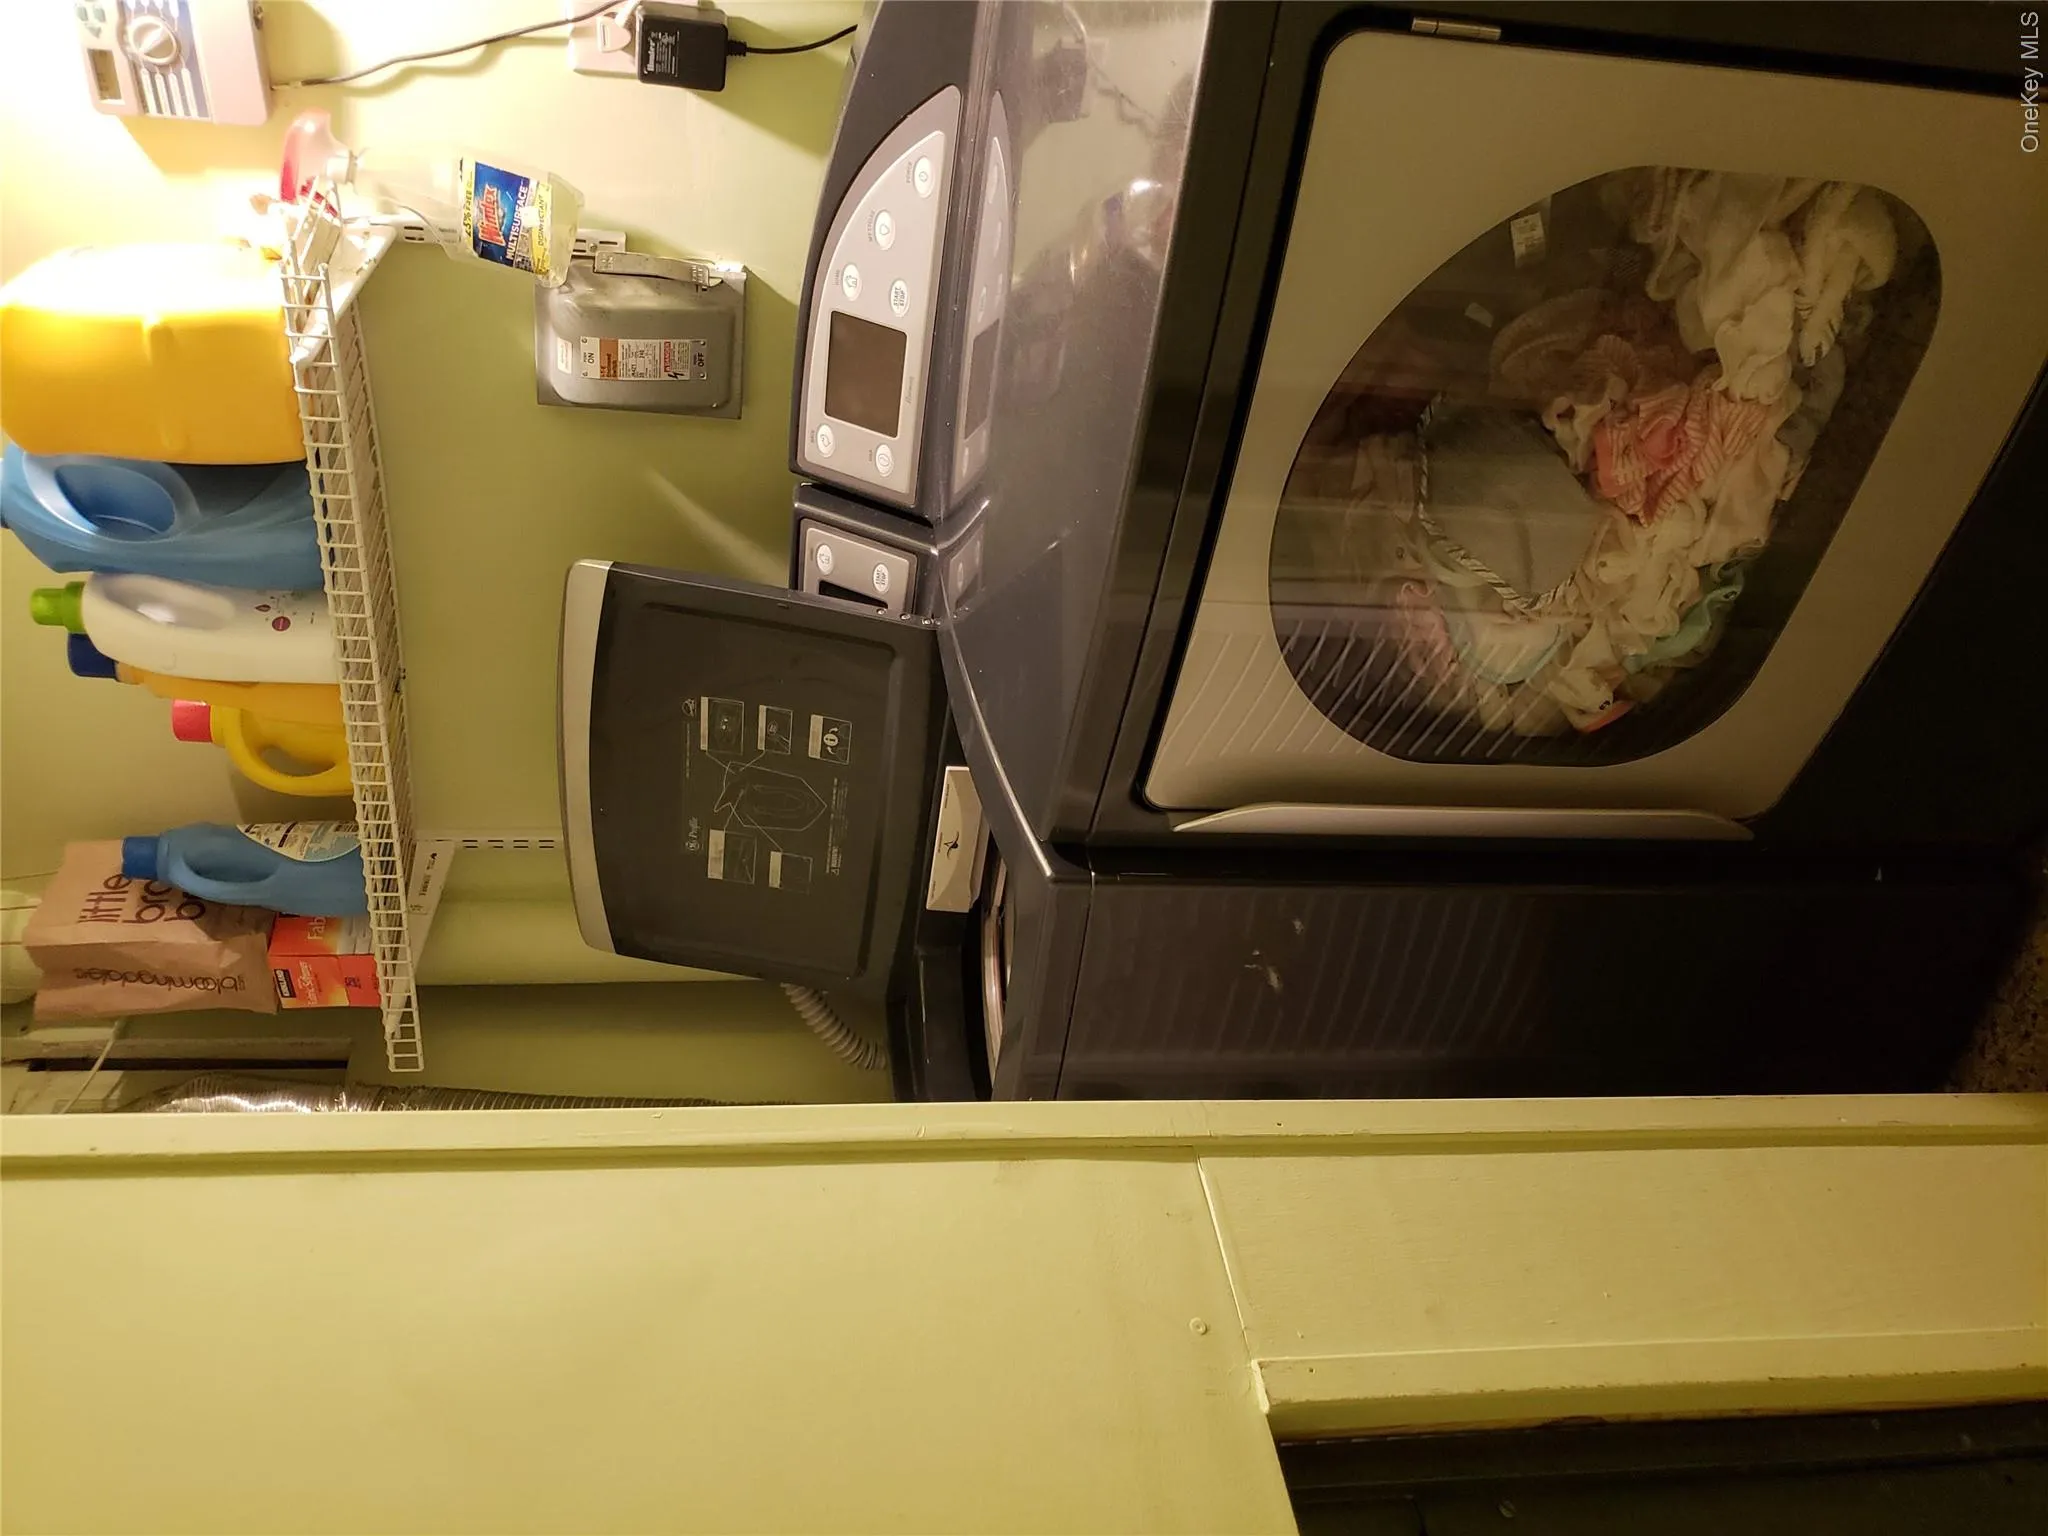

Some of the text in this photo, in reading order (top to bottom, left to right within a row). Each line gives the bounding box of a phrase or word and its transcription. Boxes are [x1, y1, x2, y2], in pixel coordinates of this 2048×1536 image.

[478, 185, 505, 245] Windex
[506, 186, 528, 260] MULTISURFACE
[588, 353, 594, 363] ON
[76, 874, 131, 923] little
[276, 970, 290, 997] KIRKLAND
